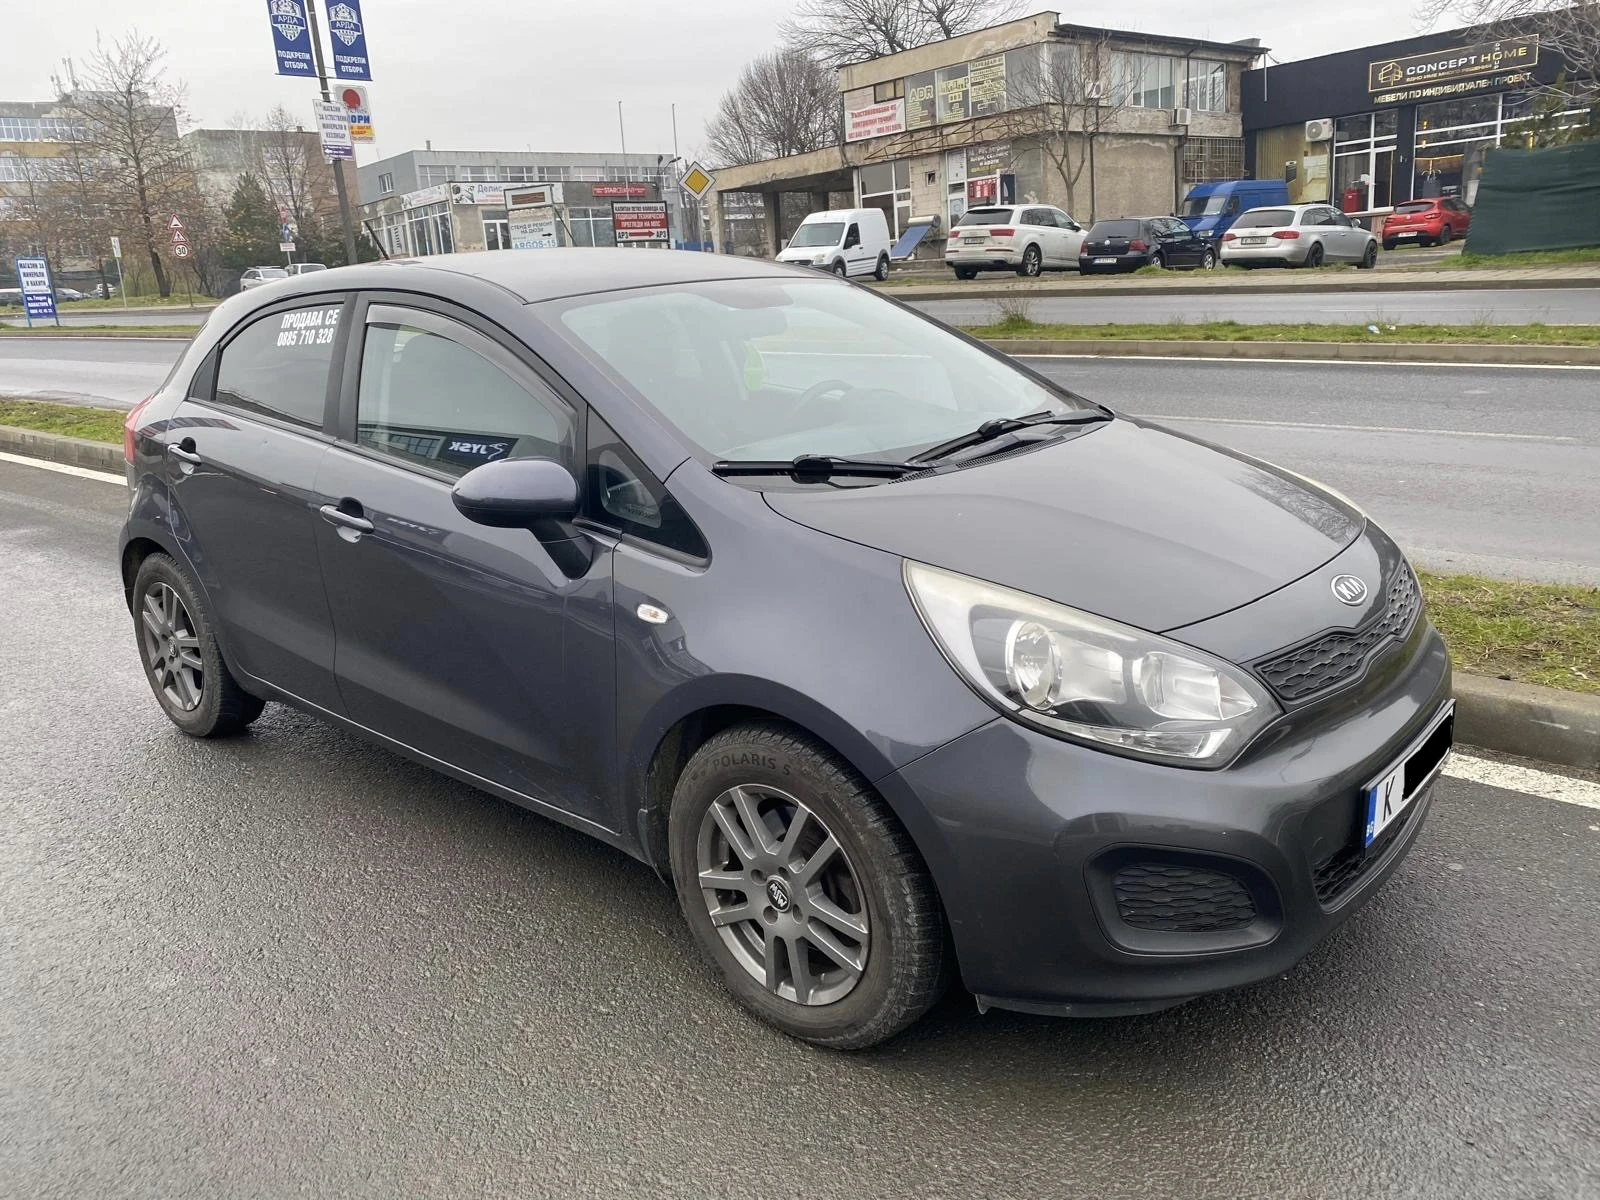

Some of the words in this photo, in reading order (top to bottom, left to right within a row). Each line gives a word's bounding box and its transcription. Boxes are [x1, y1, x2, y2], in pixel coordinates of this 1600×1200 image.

[278, 15, 298, 25] АРДА
[336, 20, 355, 30] АРДА
[277, 50, 311, 60] ПОДКРЕПИ
[336, 54, 366, 64] ПОДКРЕПИ
[1406, 55, 1477, 75] CONCEPT
[1481, 46, 1528, 62] HOME
[284, 60, 308, 70] ОТБОРА
[342, 65, 364, 74] ОТБОРА
[909, 84, 934, 102] ADR
[1374, 92, 1408, 104] МЕБЕЛИ
[1409, 90, 1421, 100] ПО
[1494, 72, 1532, 86] ПРОЕКТ
[177, 247, 186, 255] 30
[281, 310, 324, 330] ПРОДАВА
[325, 309, 340, 326] СЕ
[277, 330, 298, 347] 0885
[299, 329, 316, 345] 710
[316, 328, 334, 344] 328
[1336, 578, 1365, 600] KIA
[712, 753, 777, 770] POLARIS
[1383, 775, 1396, 822] K
